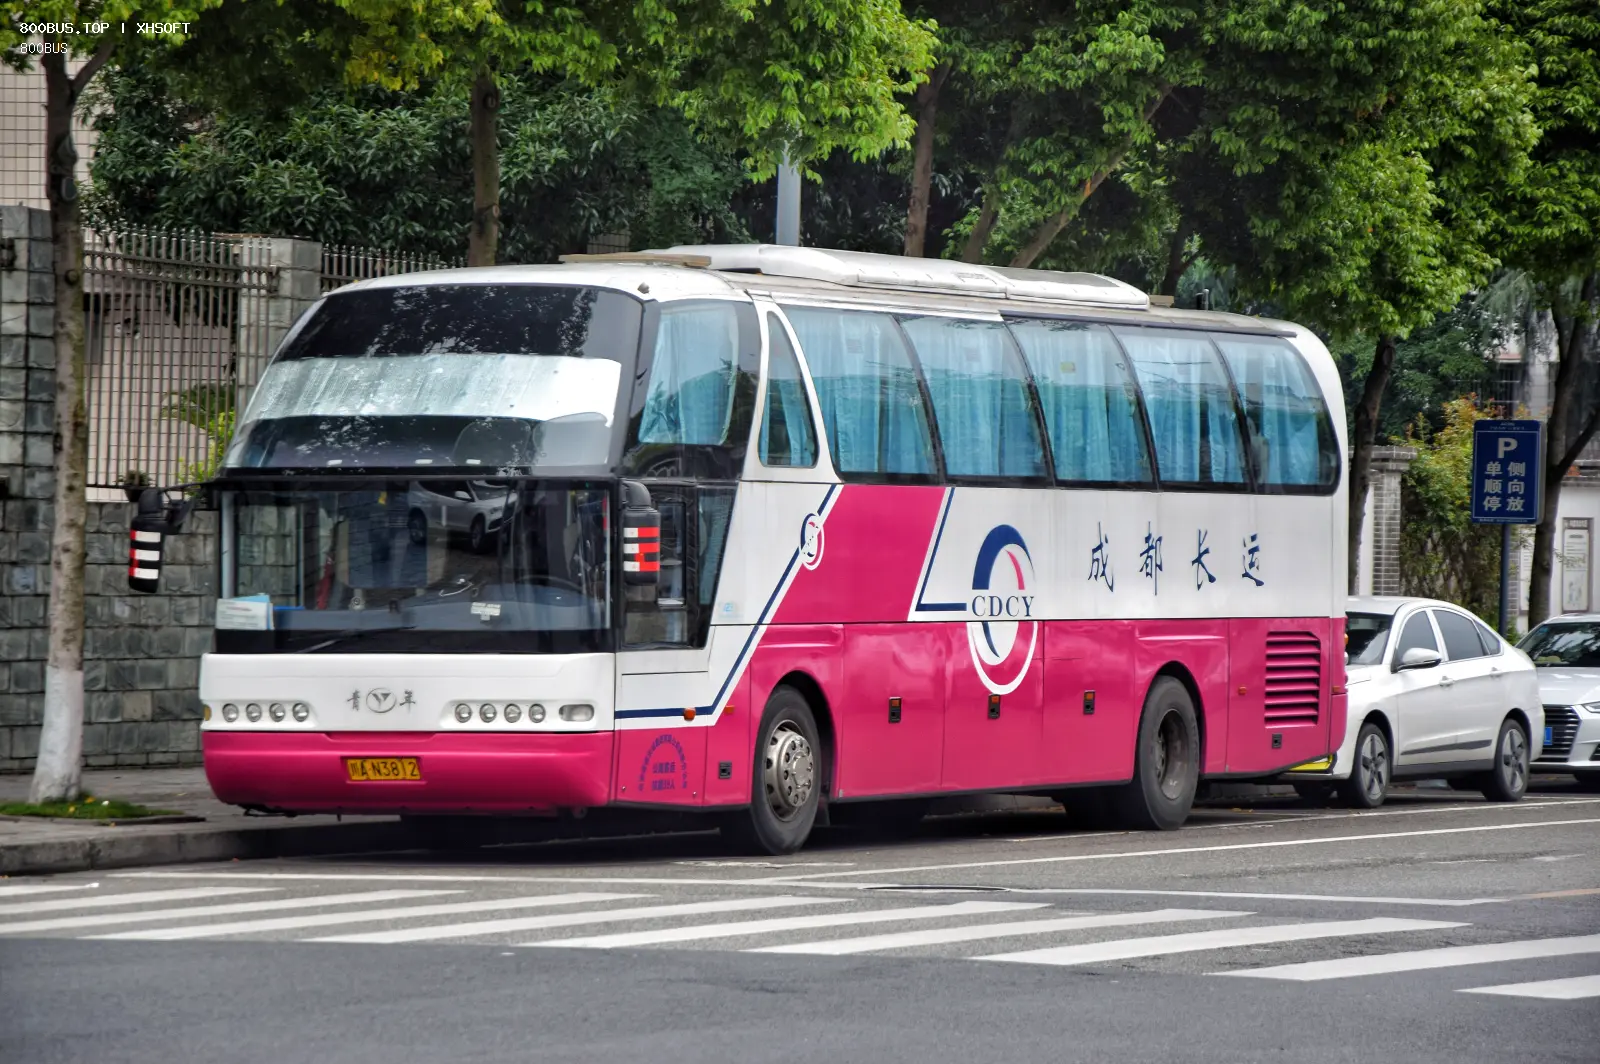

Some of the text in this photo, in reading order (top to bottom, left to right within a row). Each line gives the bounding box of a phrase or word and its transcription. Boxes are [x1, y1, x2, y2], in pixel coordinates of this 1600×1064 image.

[1497, 437, 1518, 459] P
[1484, 461, 1526, 477] 单侧
[1483, 478, 1526, 494] 顺向
[1482, 495, 1525, 512] 停放
[1087, 520, 1265, 596] 成都长运
[971, 595, 1035, 617] CDCY
